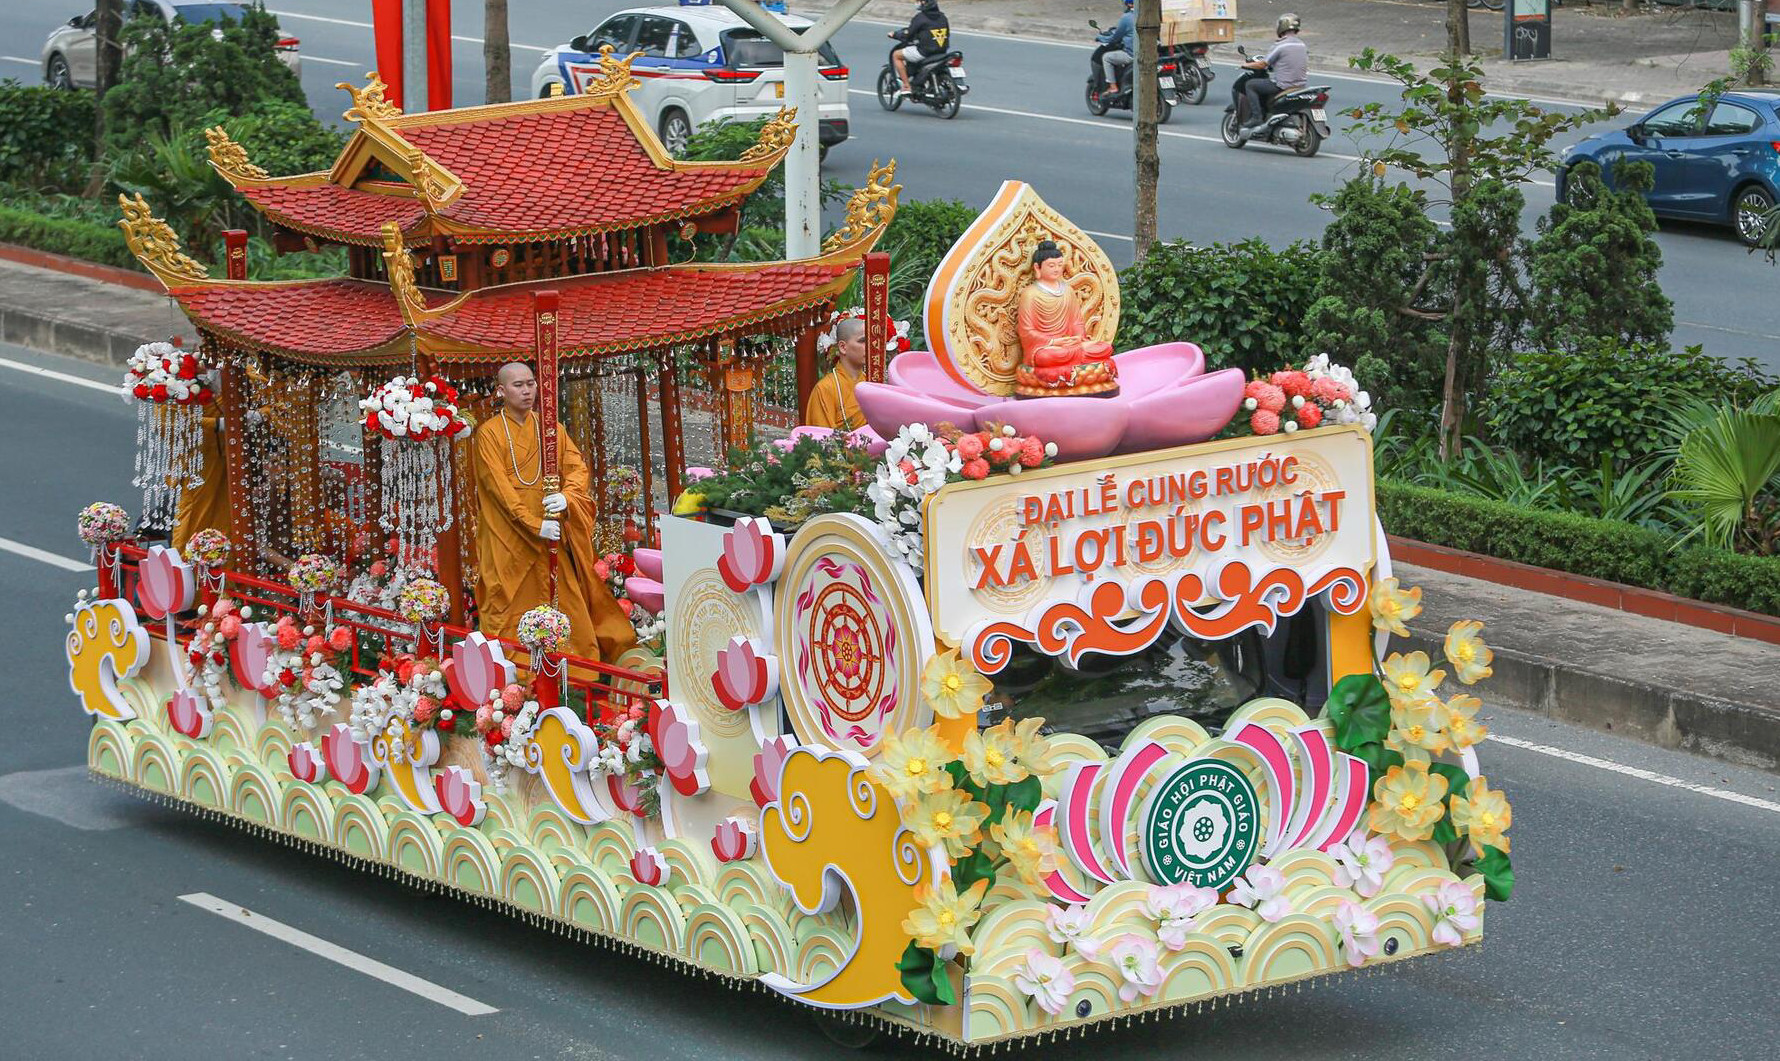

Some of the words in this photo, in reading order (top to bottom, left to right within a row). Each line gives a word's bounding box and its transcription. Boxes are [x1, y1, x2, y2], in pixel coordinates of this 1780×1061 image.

[1020, 490, 1075, 528] ĐẠI
[1083, 473, 1118, 515] LỄ
[1127, 470, 1208, 509] CUNG
[1215, 453, 1299, 496] RƯỚC
[975, 529, 1038, 589] XÁ
[1049, 526, 1127, 582] LỢI
[1135, 502, 1227, 563] ĐỨC
[1241, 490, 1346, 546] PHẬT
[1157, 808, 1172, 849] GIÁO
[1170, 779, 1195, 804] HỘI
[1200, 775, 1235, 793] PHẬT
[1233, 794, 1250, 832] GIÁO
[1208, 855, 1237, 883] NAM
